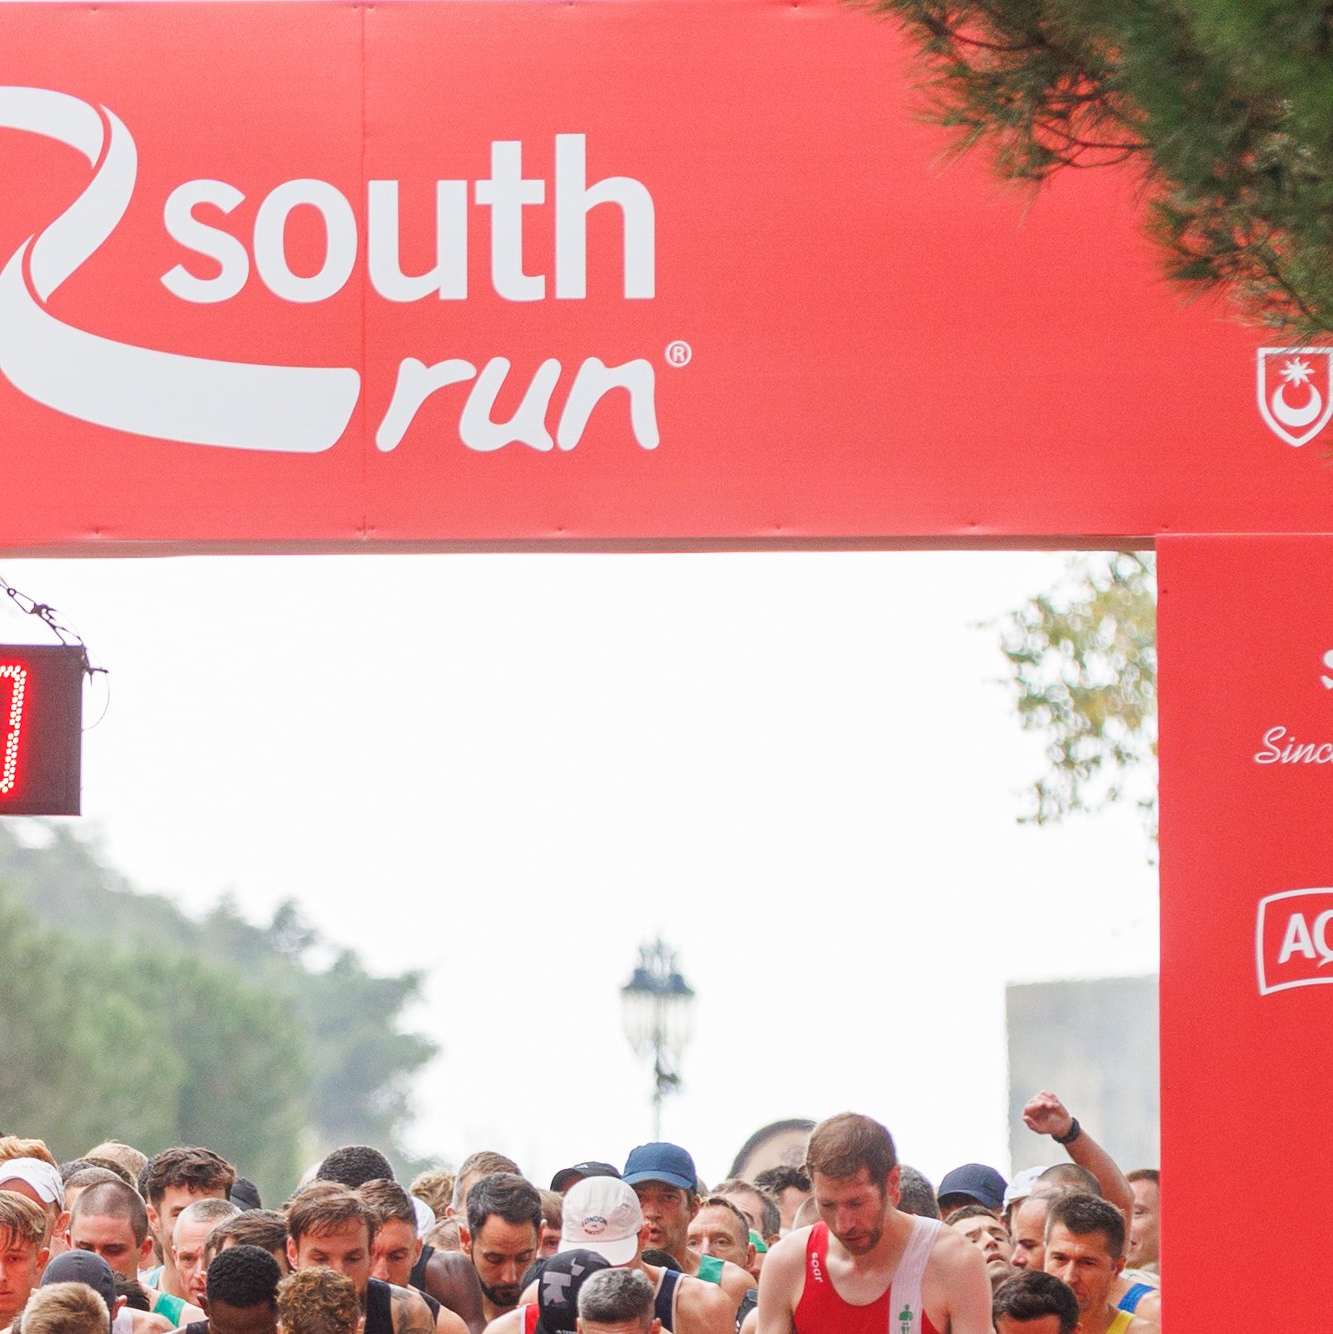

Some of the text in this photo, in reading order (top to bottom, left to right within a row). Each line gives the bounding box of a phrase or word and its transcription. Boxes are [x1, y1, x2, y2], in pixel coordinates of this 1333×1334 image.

[160, 131, 656, 304] south
[375, 355, 660, 452] run
[1254, 725, 1333, 765] Sinc
[811, 1251, 824, 1283] soar
